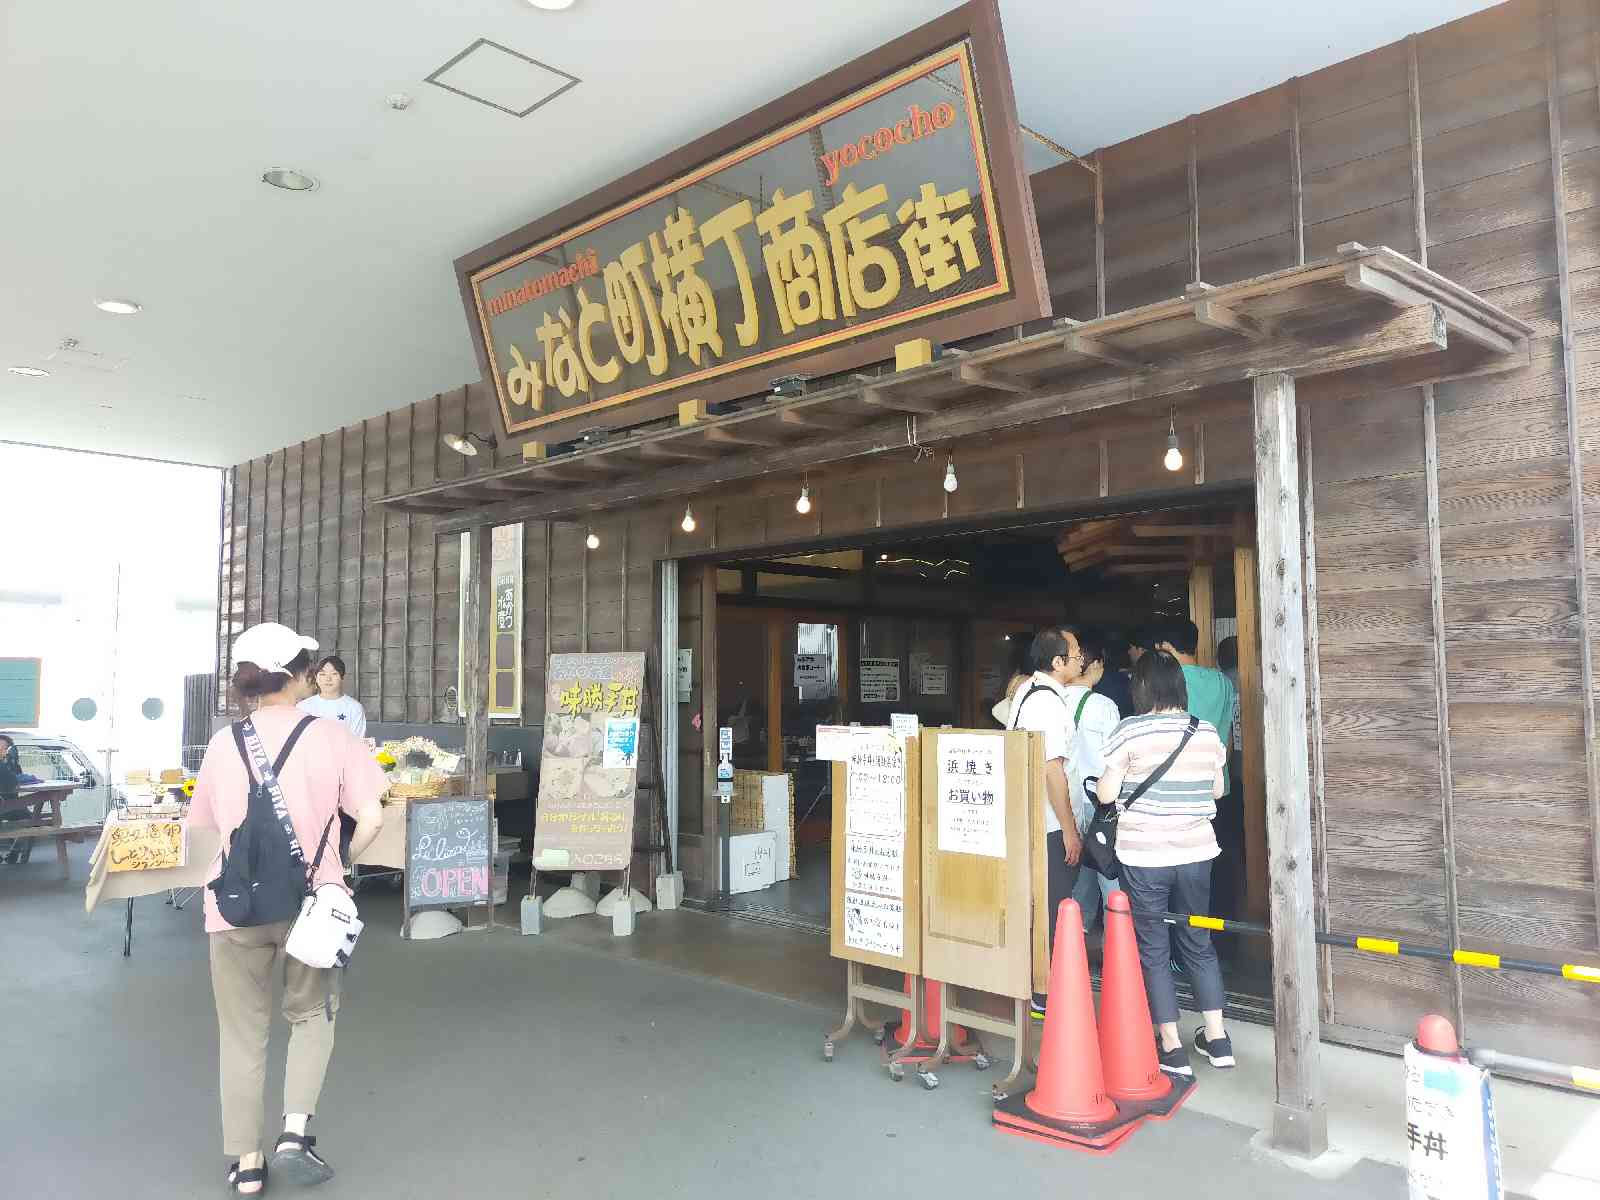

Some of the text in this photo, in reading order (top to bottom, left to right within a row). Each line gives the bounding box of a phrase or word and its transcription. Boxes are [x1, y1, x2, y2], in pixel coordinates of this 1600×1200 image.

[820, 102, 957, 187] yococho
[487, 249, 600, 317] minatomachi
[506, 182, 982, 412] みなと町横丁商店街
[948, 787, 995, 806] お買い物
[420, 864, 489, 897] OPEN
